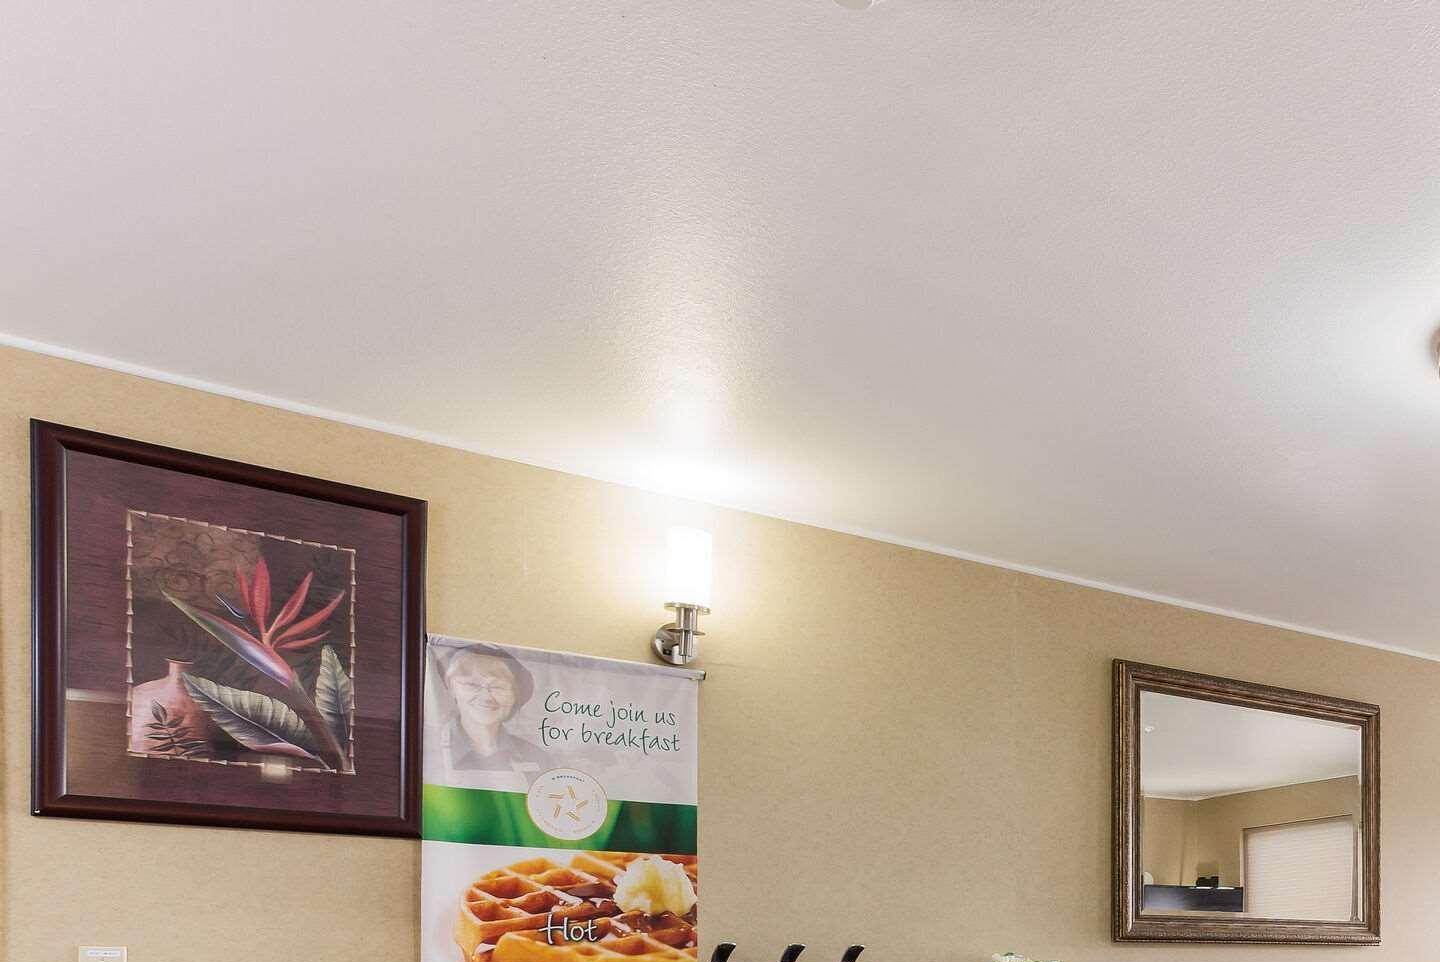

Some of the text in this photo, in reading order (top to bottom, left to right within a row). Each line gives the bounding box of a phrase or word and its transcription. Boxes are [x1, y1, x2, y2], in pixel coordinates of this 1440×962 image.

[544, 690, 676, 728] Come join us
[538, 717, 681, 756] for breakfast
[538, 911, 598, 945] Hot
